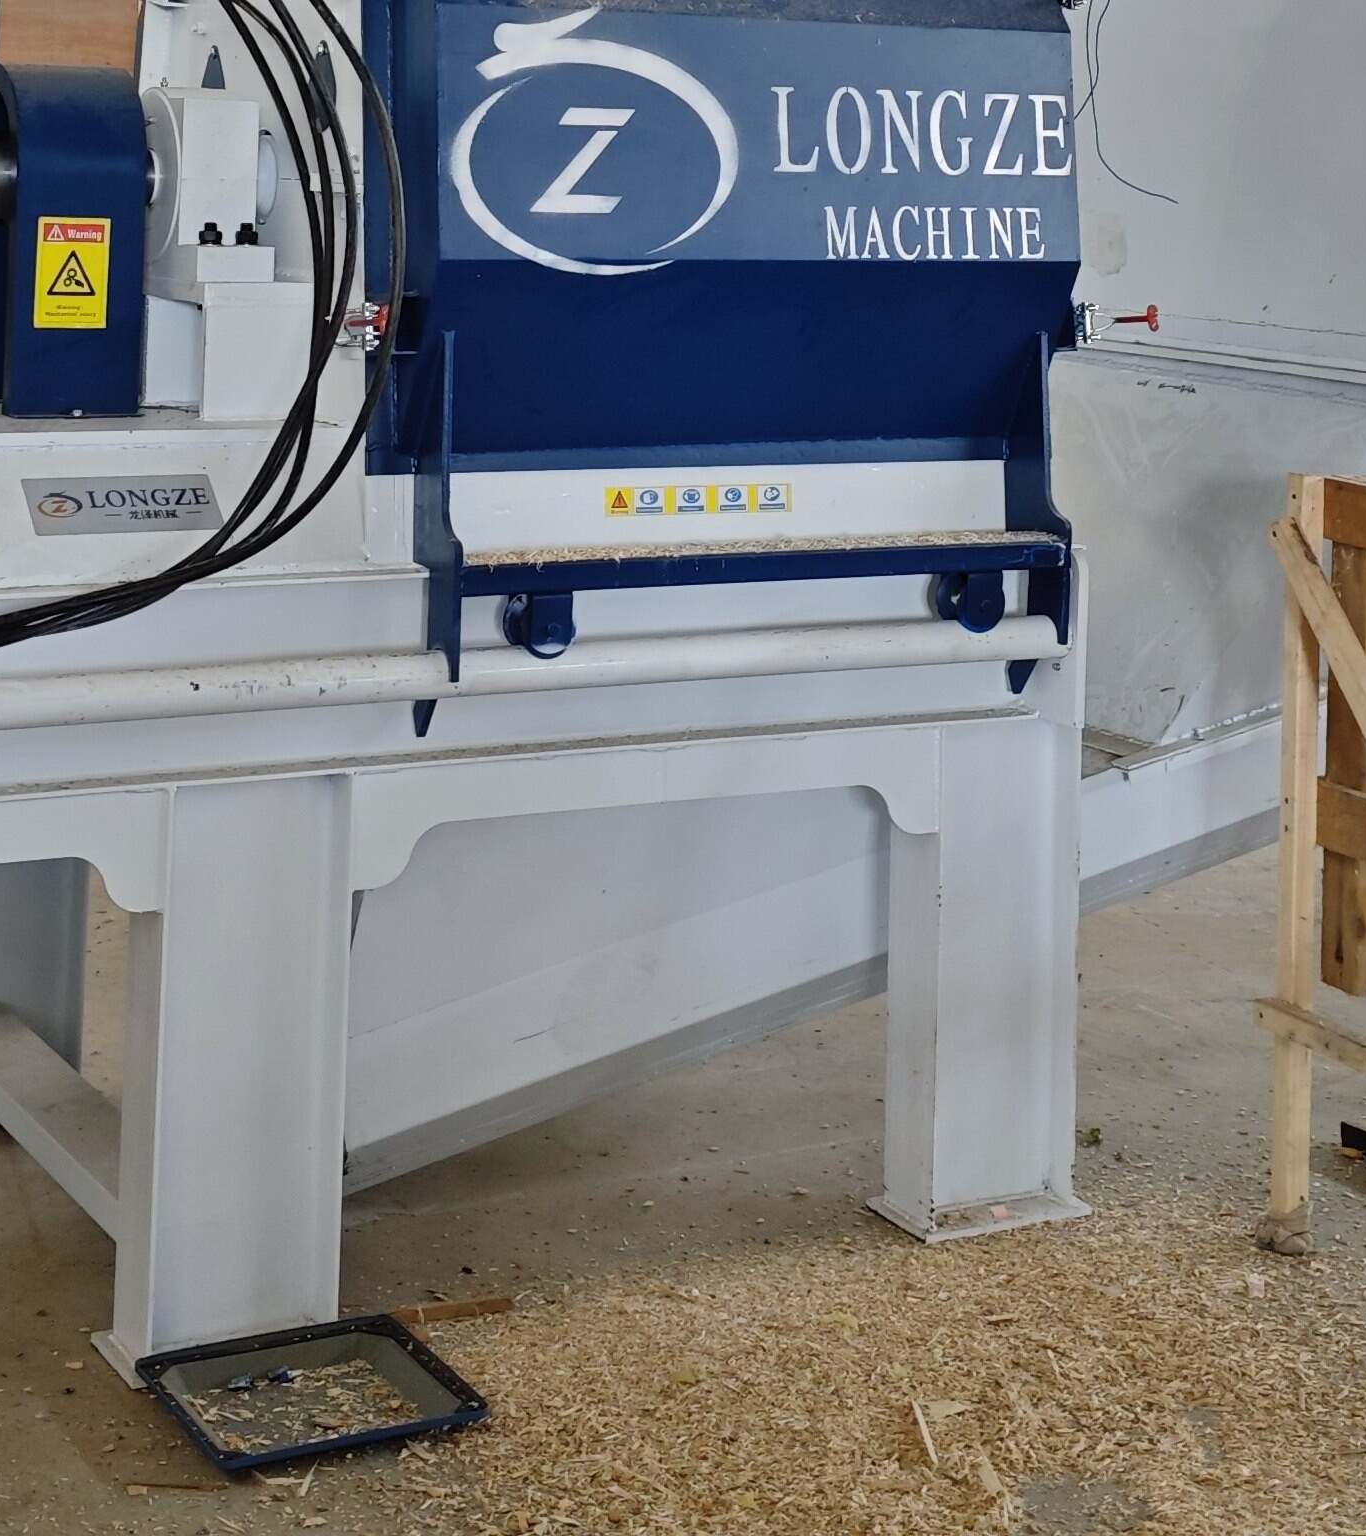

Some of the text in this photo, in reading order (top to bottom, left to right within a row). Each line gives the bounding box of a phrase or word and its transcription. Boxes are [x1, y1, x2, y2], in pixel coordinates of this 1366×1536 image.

[770, 85, 1073, 177] LONGZE
[529, 106, 636, 214] Z
[67, 228, 102, 242] Warning
[823, 205, 1046, 261] MACHINE
[85, 487, 210, 509] LONGZE
